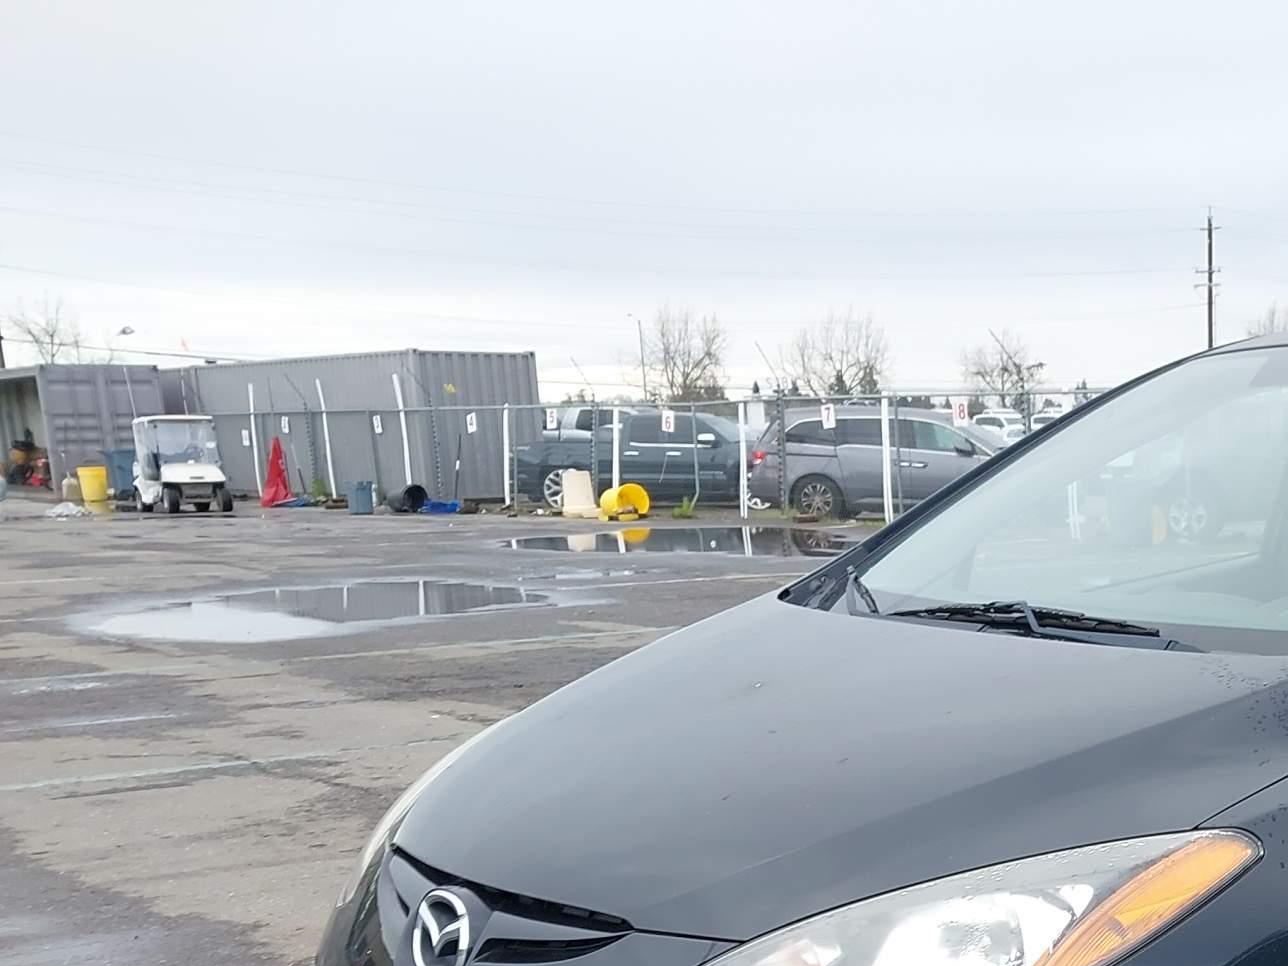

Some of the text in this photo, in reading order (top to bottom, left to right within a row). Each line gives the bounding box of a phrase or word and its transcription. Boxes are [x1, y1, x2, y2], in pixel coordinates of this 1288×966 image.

[549, 410, 555, 424] 5
[824, 407, 831, 423] 7
[958, 403, 966, 420] 8
[665, 415, 671, 430] 6
